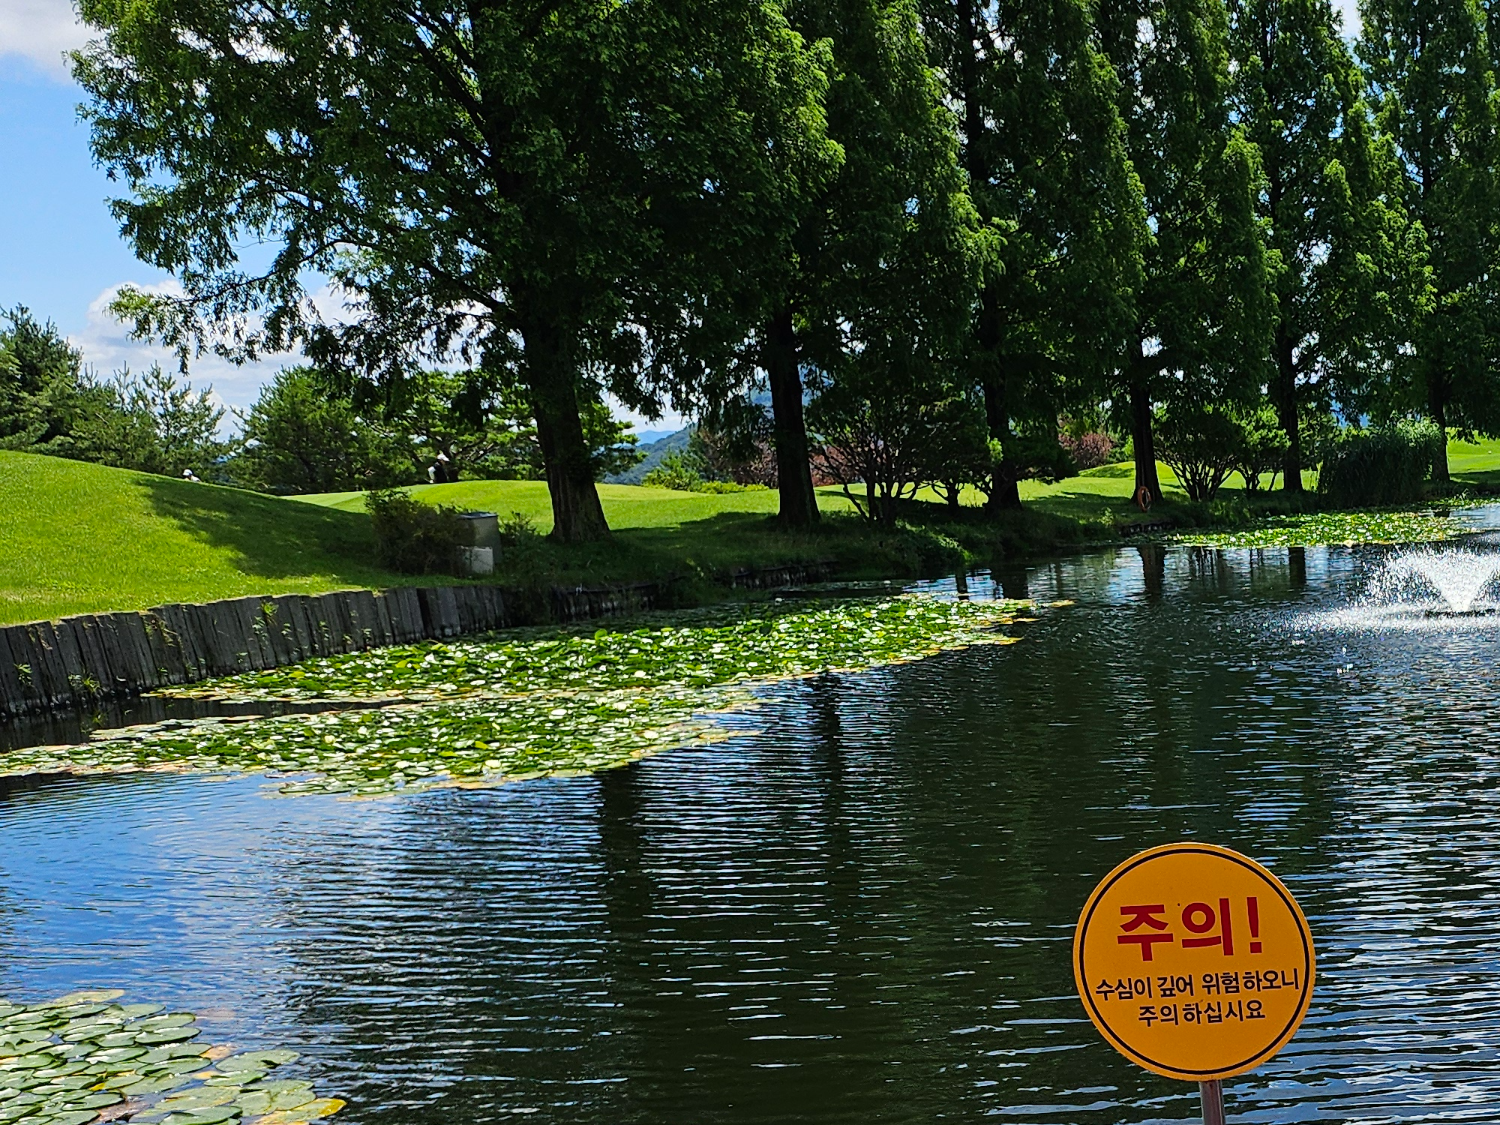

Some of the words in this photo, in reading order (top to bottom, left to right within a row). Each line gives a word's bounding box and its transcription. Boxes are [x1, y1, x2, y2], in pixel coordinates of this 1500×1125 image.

[1117, 896, 1263, 962] 주의!
[1095, 976, 1153, 1001] 수심이
[1157, 974, 1195, 998] 깊어
[1201, 968, 1300, 996] 위험하오니
[1138, 999, 1266, 1027] 주의하십시요
